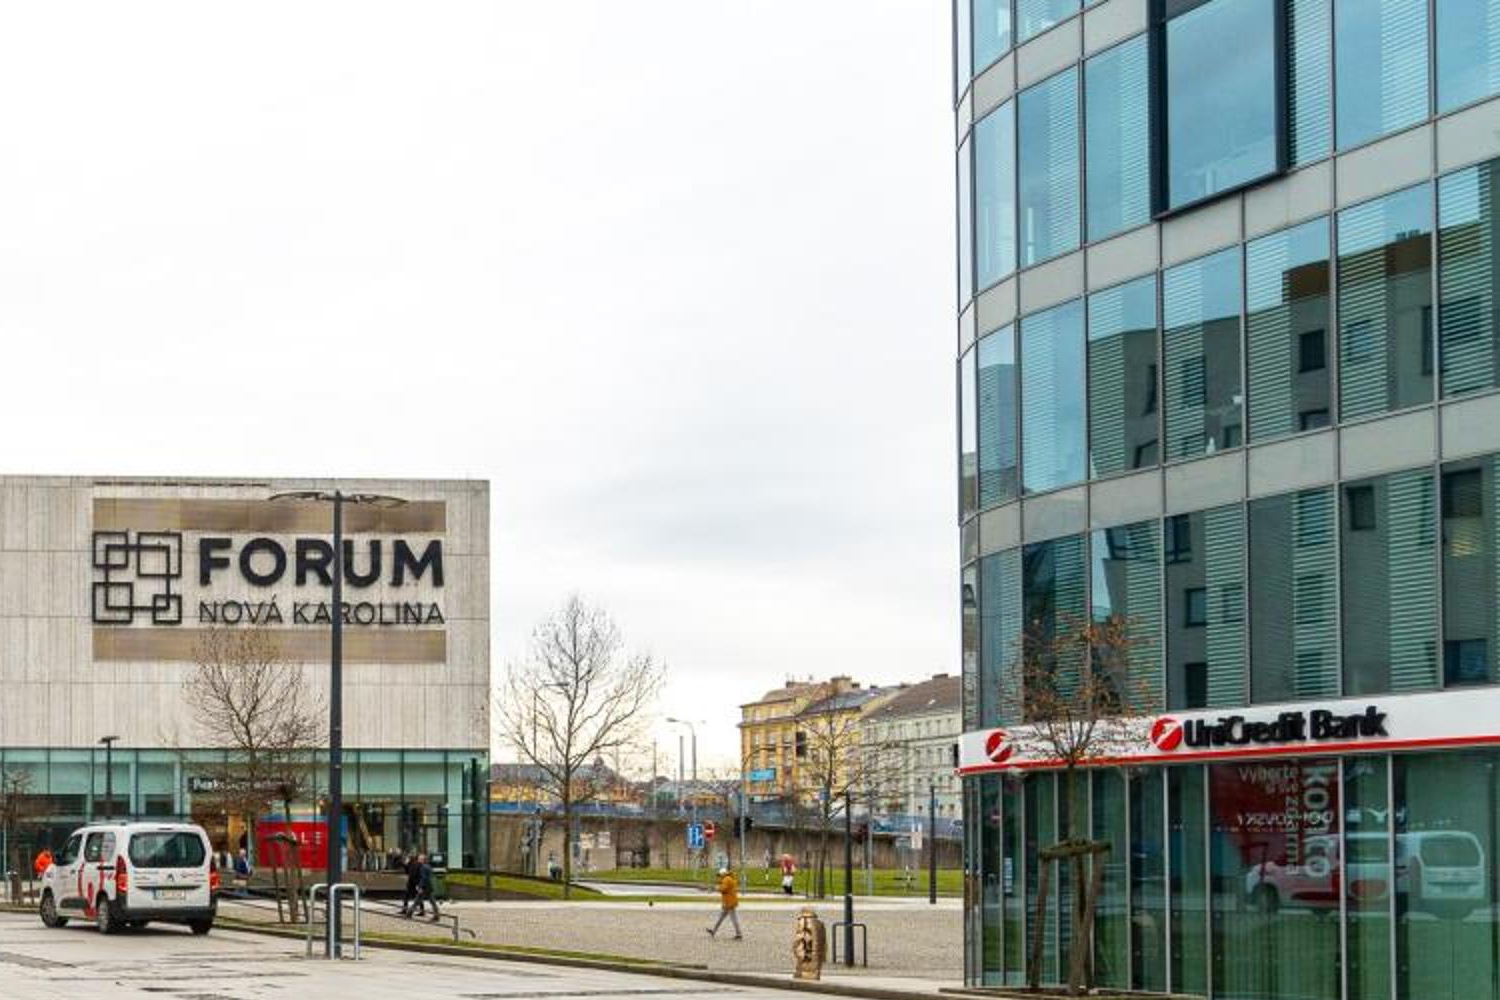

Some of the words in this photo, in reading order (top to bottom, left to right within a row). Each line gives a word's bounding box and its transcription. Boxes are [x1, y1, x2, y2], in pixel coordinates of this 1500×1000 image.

[200, 537, 445, 588] FORUM
[199, 594, 284, 625] NOVÁ
[293, 601, 445, 626] KAROLINA
[1183, 711, 1307, 748] UniCredit
[1309, 705, 1389, 740] Bank
